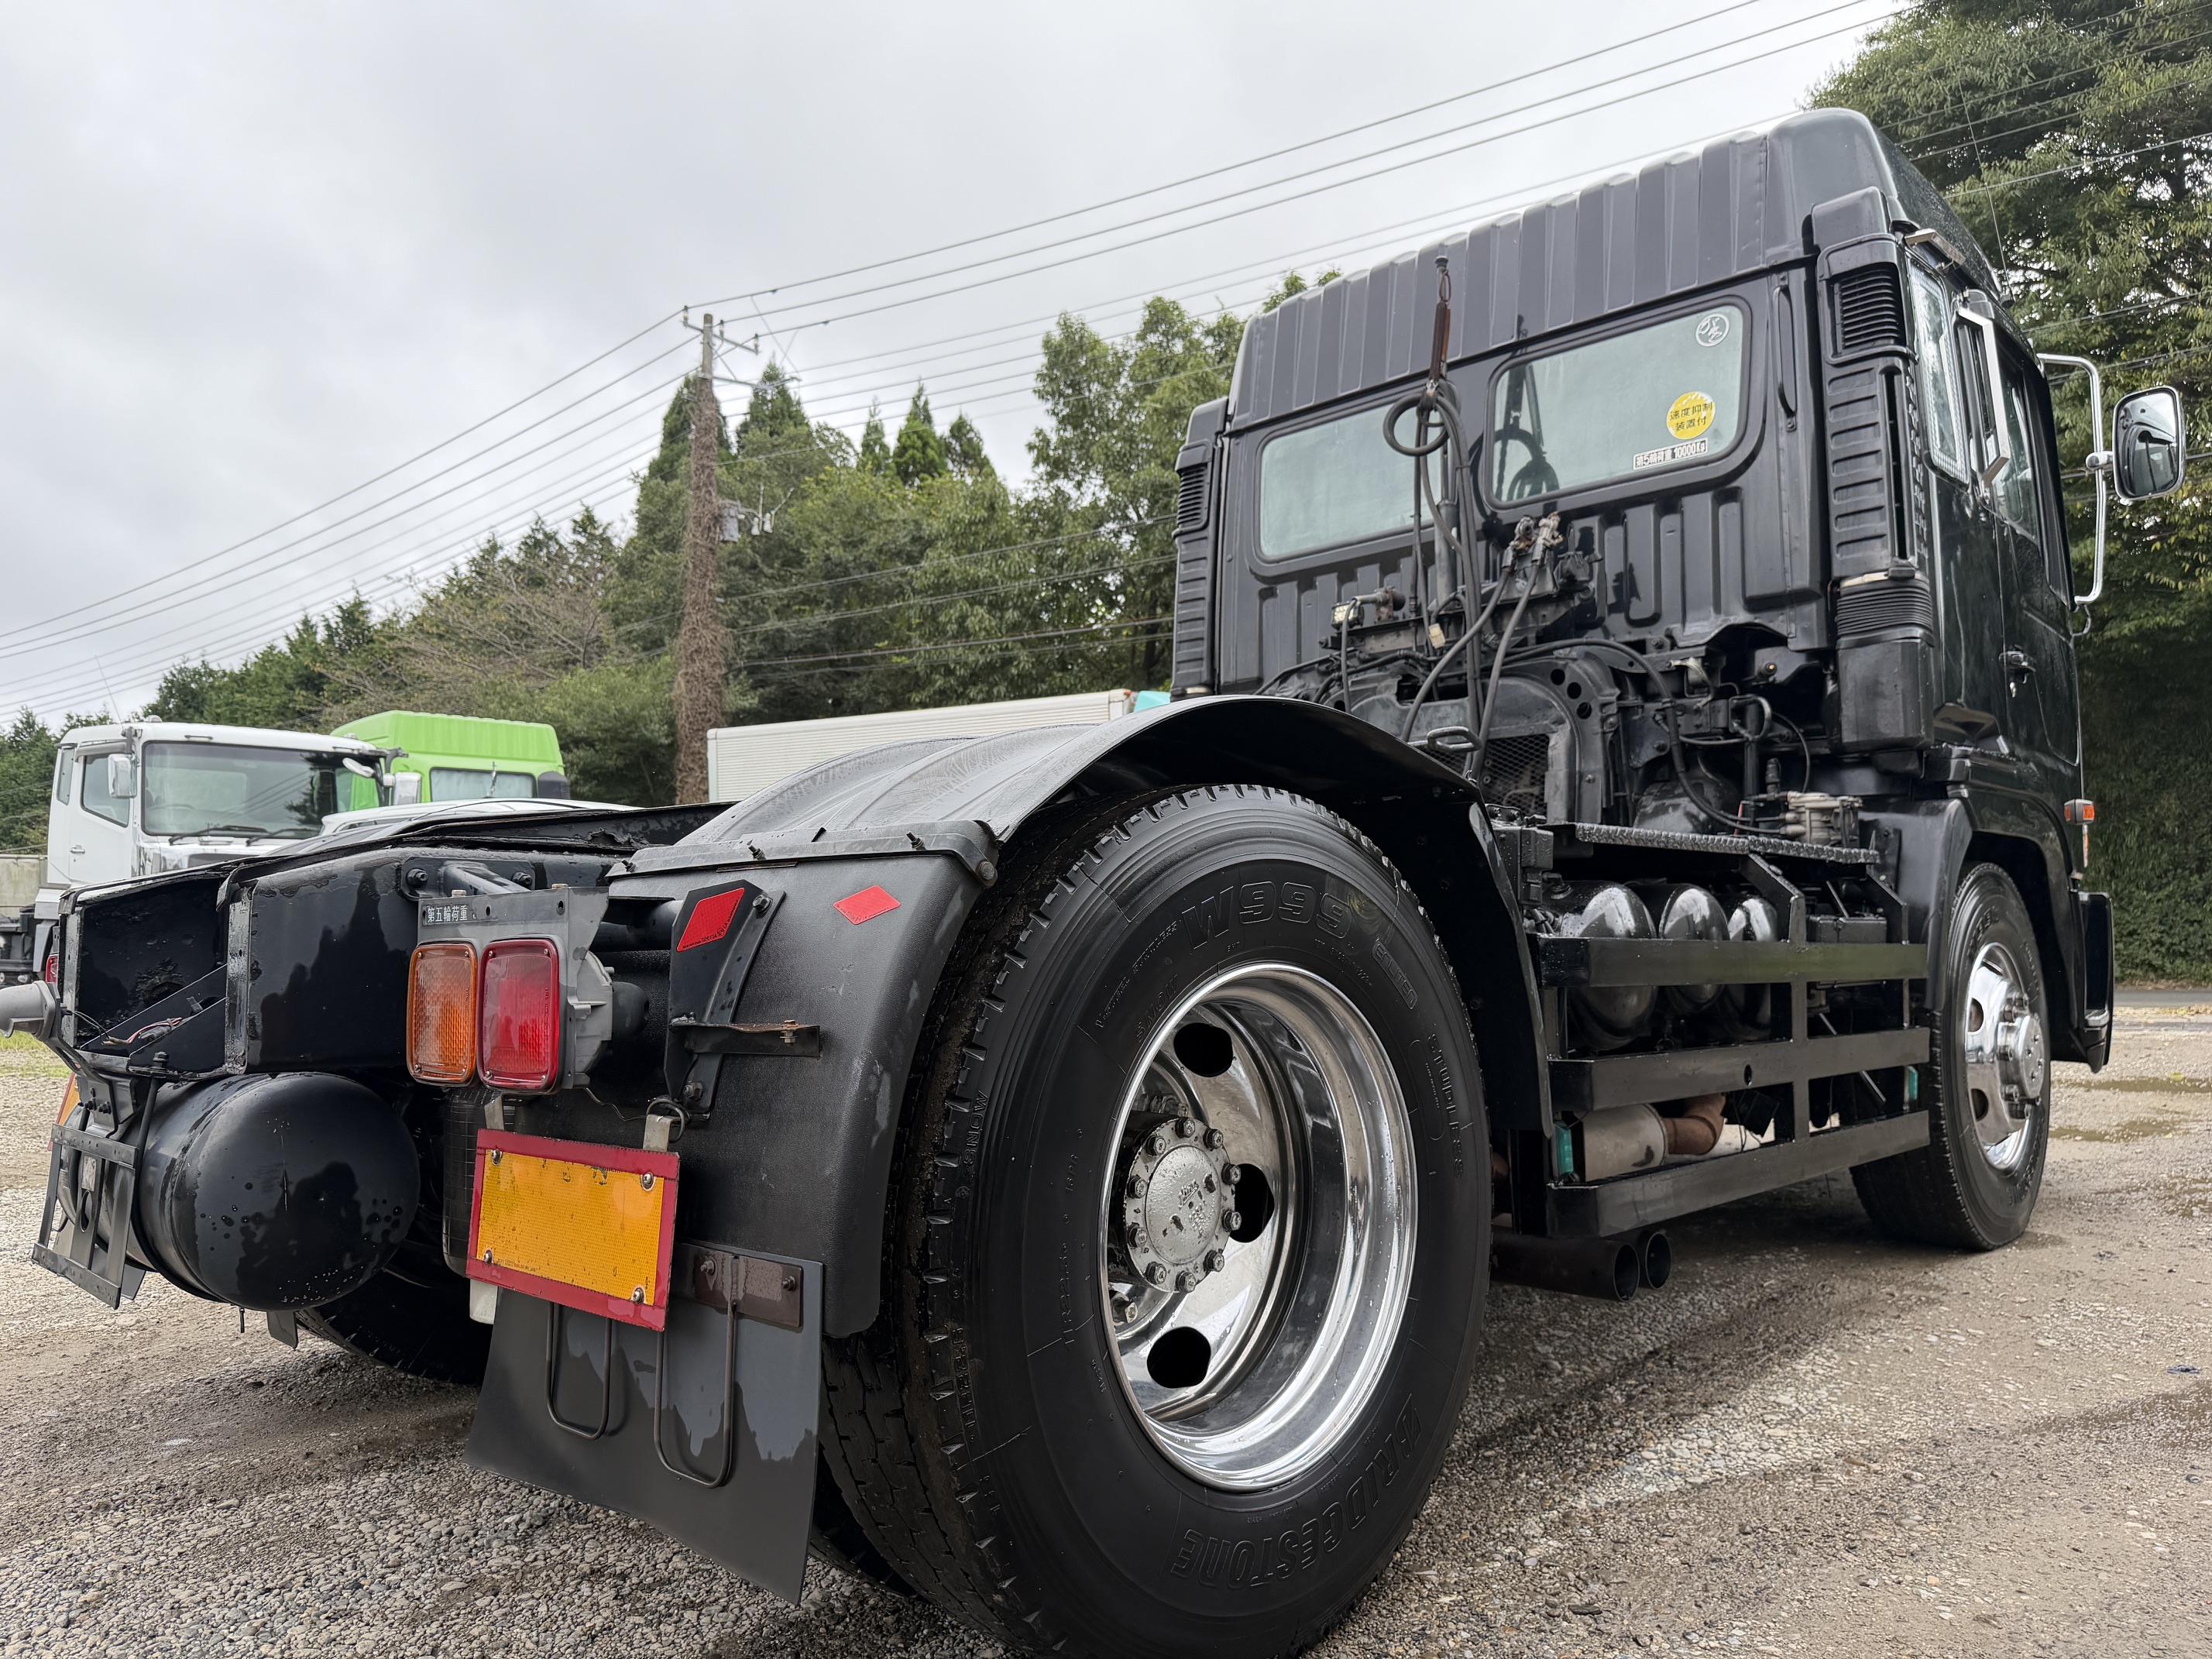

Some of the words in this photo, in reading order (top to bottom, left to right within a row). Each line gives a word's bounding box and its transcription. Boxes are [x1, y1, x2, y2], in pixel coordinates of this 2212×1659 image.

[1670, 401, 1713, 421] 速度抑制
[1675, 415, 1707, 431] 装置付
[427, 905, 468, 923] 第五輪荷重
[1182, 880, 1354, 950] W999
[962, 1090, 989, 1167] SNOW
[1427, 1033, 1464, 1178] STUDLESS
[1170, 1393, 1422, 1589] BRIDGESTONE
